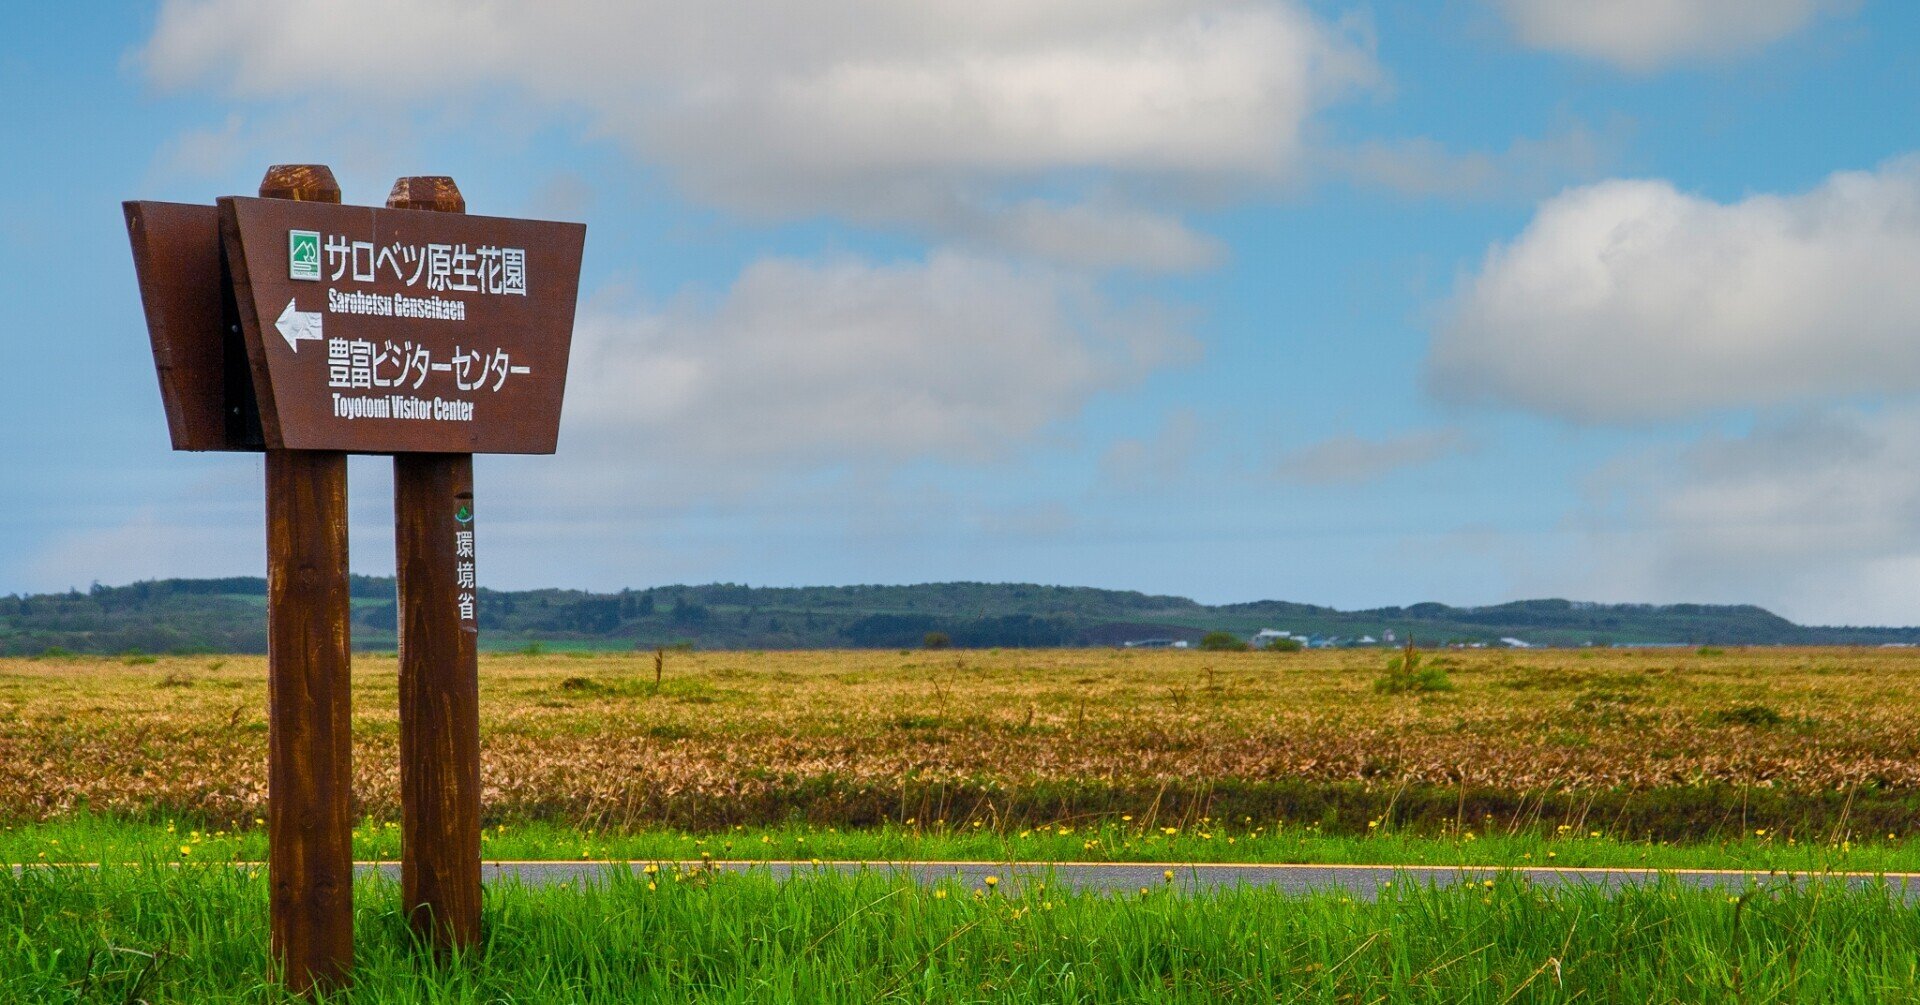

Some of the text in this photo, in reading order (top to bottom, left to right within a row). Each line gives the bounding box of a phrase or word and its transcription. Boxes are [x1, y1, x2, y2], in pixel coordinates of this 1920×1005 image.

[324, 234, 527, 297] サロベツ原生花園
[328, 288, 465, 321] Sarobetsu Genseikaen
[327, 337, 531, 392] 豊富ビジターセンター
[332, 392, 474, 421] Toyotomi Visitor Center
[455, 531, 474, 620] 環境省
